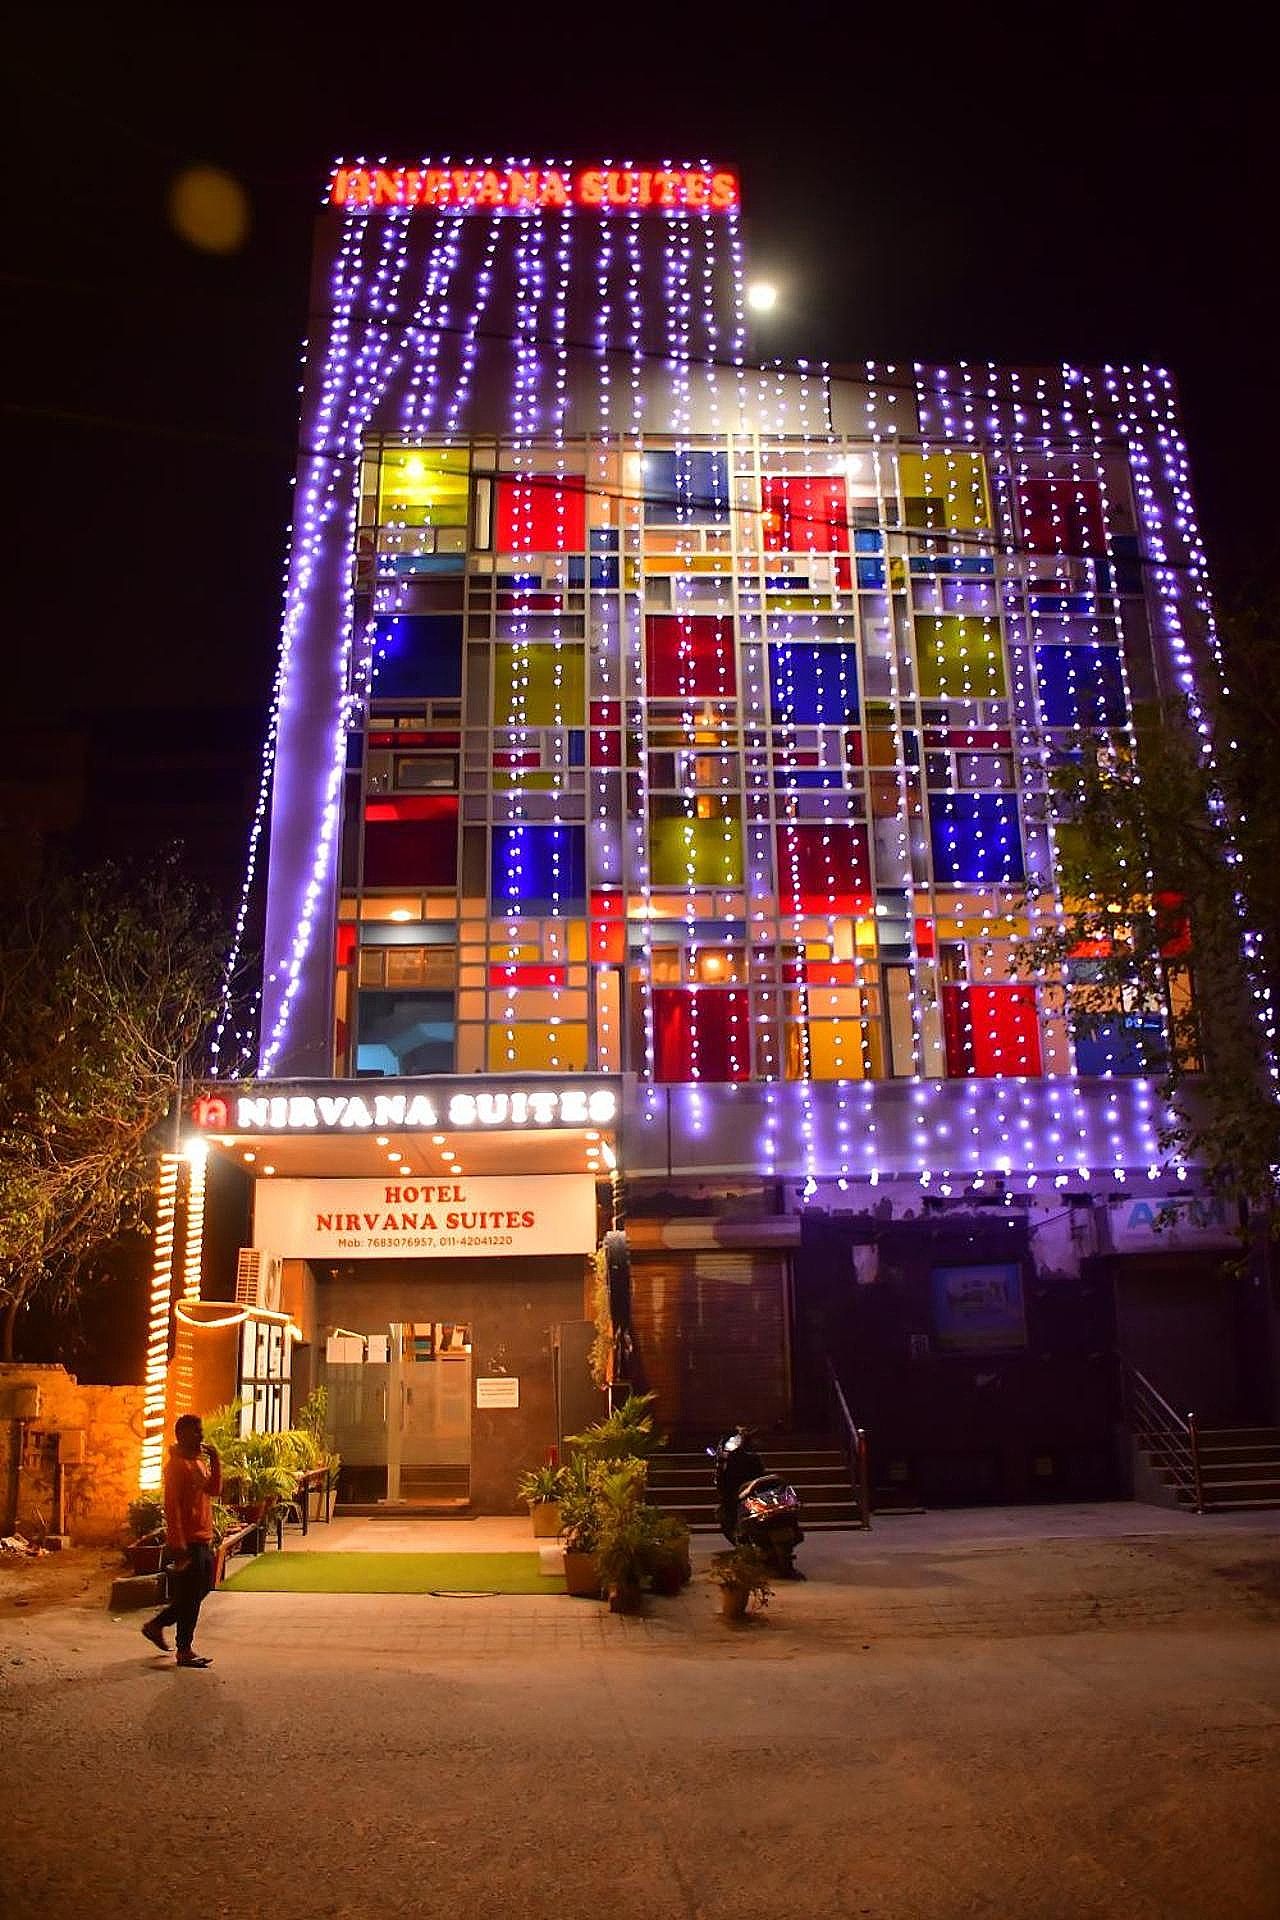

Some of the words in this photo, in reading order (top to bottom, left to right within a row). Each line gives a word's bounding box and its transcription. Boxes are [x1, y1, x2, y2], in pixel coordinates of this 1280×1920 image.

[374, 170, 568, 205] NIRVANA
[579, 170, 738, 206] SUITES
[237, 1095, 437, 1128] NIRVANA
[449, 1090, 616, 1125] SUITES
[384, 1185, 466, 1204] HOTEL
[316, 1213, 437, 1231] NIRVANA
[446, 1211, 535, 1229] SUITES
[338, 1238, 363, 1248] Mob:
